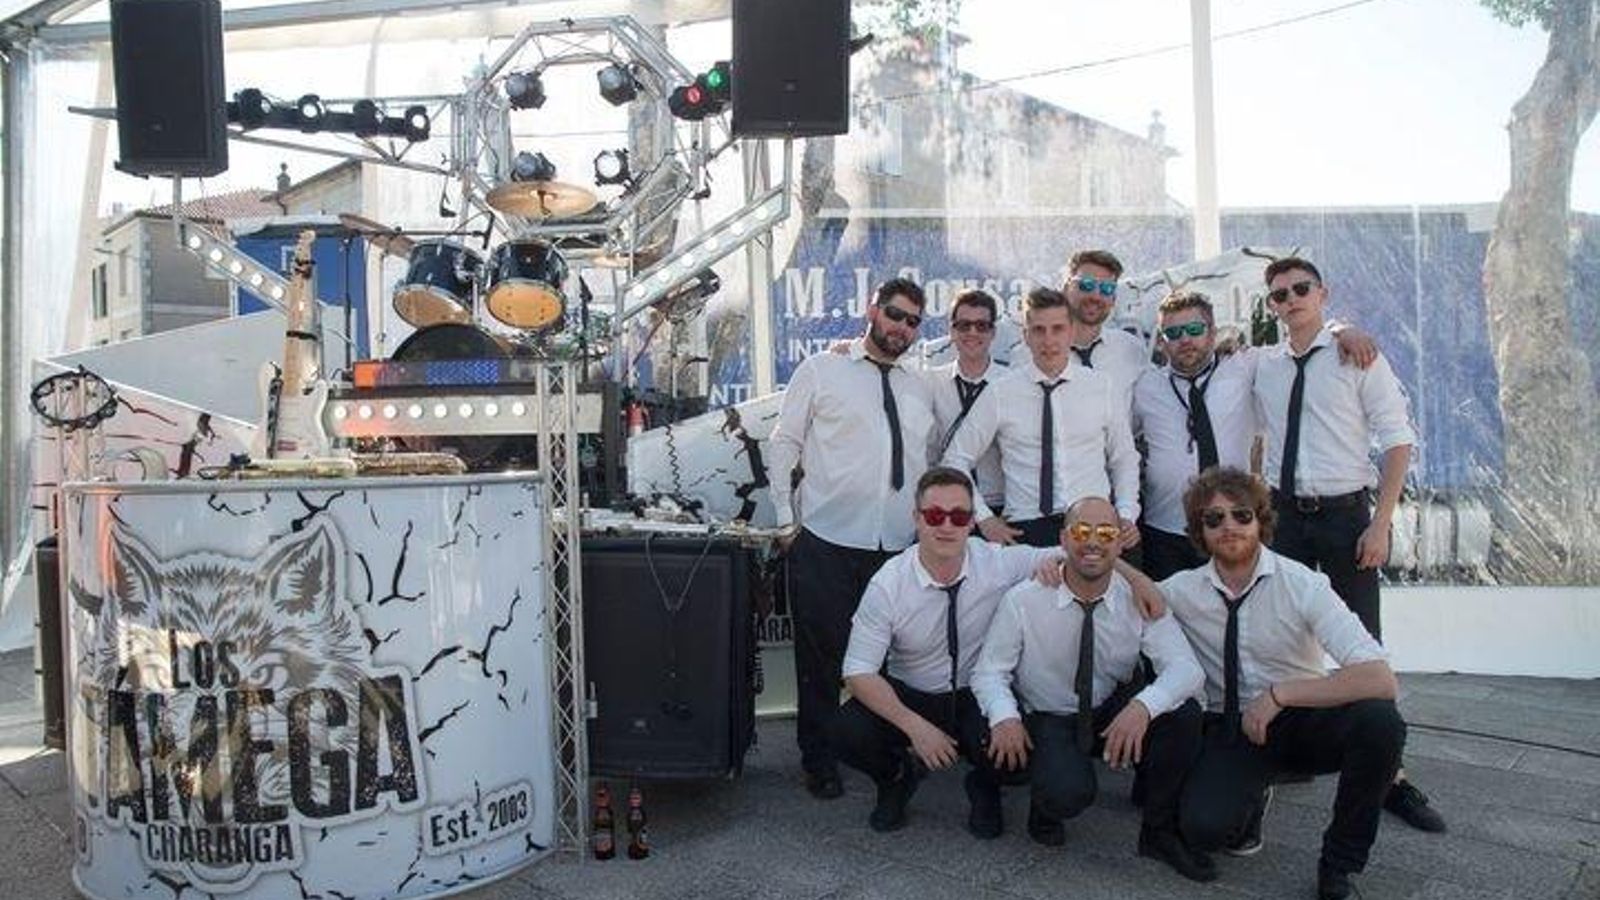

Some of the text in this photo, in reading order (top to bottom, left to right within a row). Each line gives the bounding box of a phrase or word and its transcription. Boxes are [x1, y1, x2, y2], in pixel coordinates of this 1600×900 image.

[431, 790, 527, 847] Est. 2003
[147, 823, 294, 864] CHARANGA
